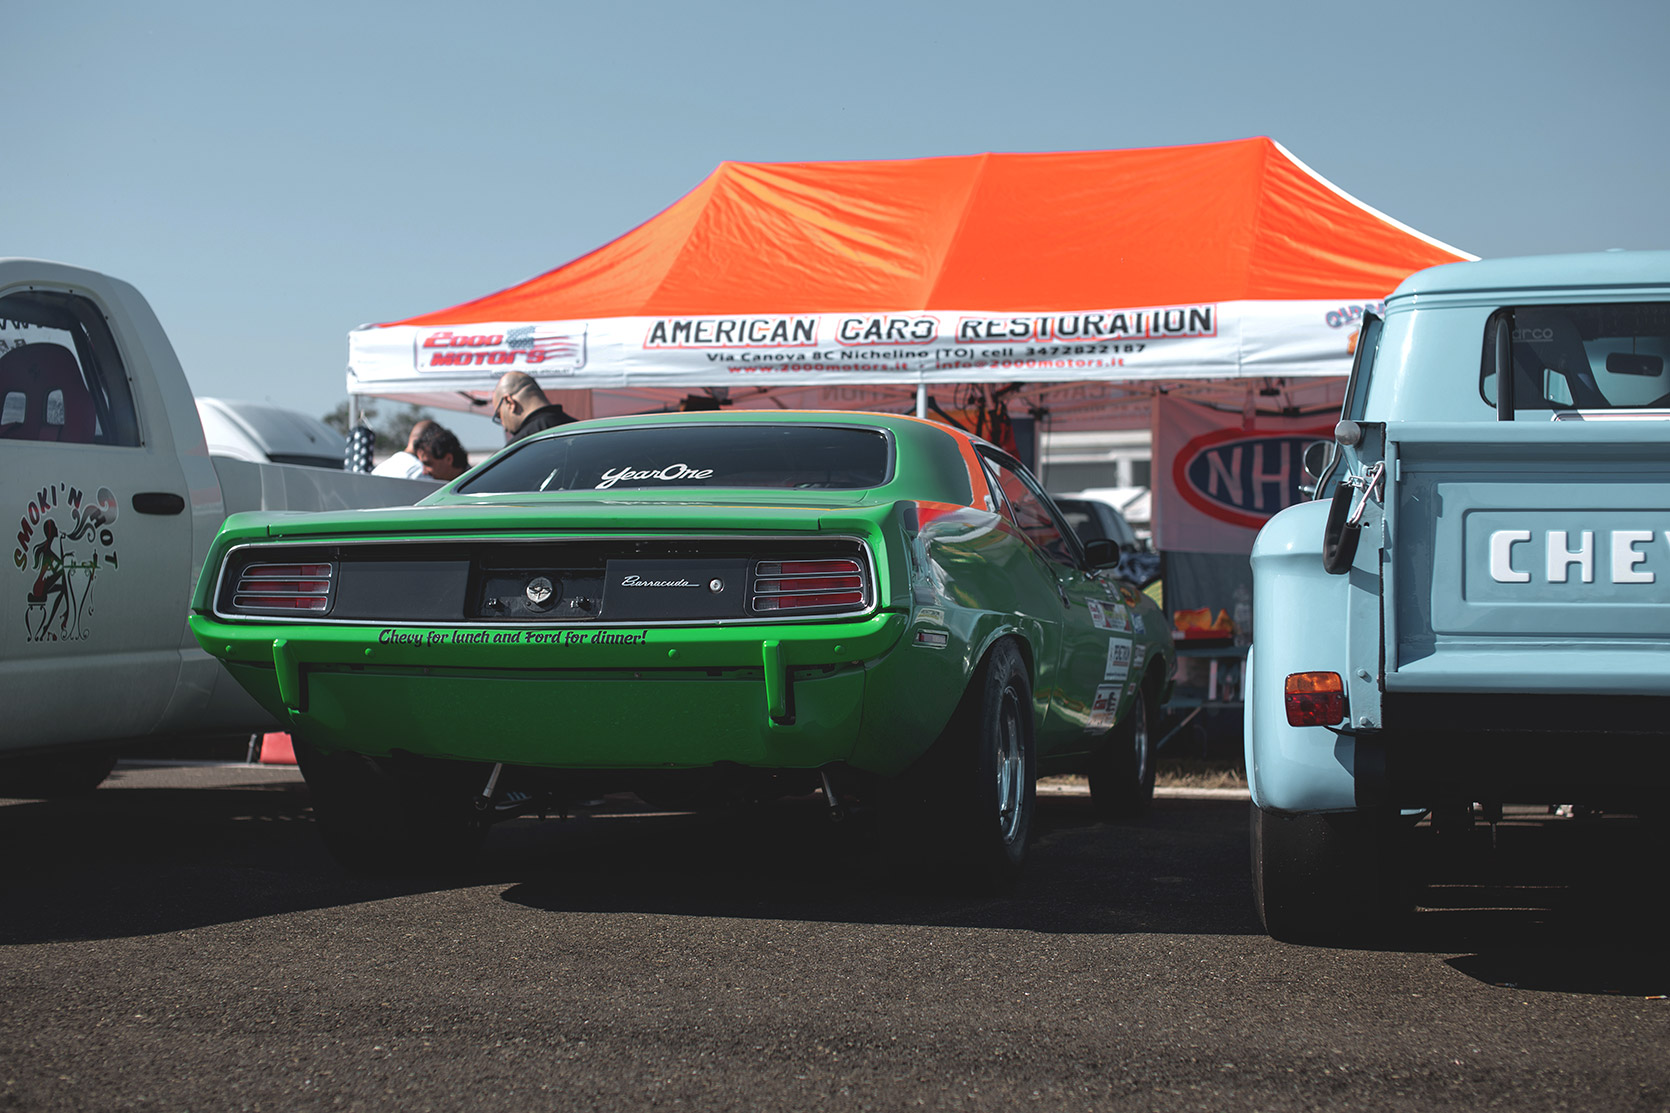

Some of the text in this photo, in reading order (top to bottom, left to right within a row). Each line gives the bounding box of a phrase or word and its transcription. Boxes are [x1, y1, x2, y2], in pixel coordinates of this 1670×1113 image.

[649, 307, 1211, 343] AMERICAN CARS RESTORATION
[706, 352, 734, 362] Via
[741, 351, 806, 361] Canova
[840, 350, 929, 360] Nichelino
[935, 348, 974, 360] (TO)
[981, 347, 1013, 358] cell
[1027, 343, 1147, 356] 3472822187
[727, 357, 1125, 373] www.2000motors.it info@2000motors.it
[594, 463, 714, 490] YearOne
[1206, 441, 1312, 509] NH
[1490, 530, 1670, 583] CHE
[621, 575, 700, 587] Barracuda
[378, 629, 648, 647] Chevy for lunch and Ford for dinner!
